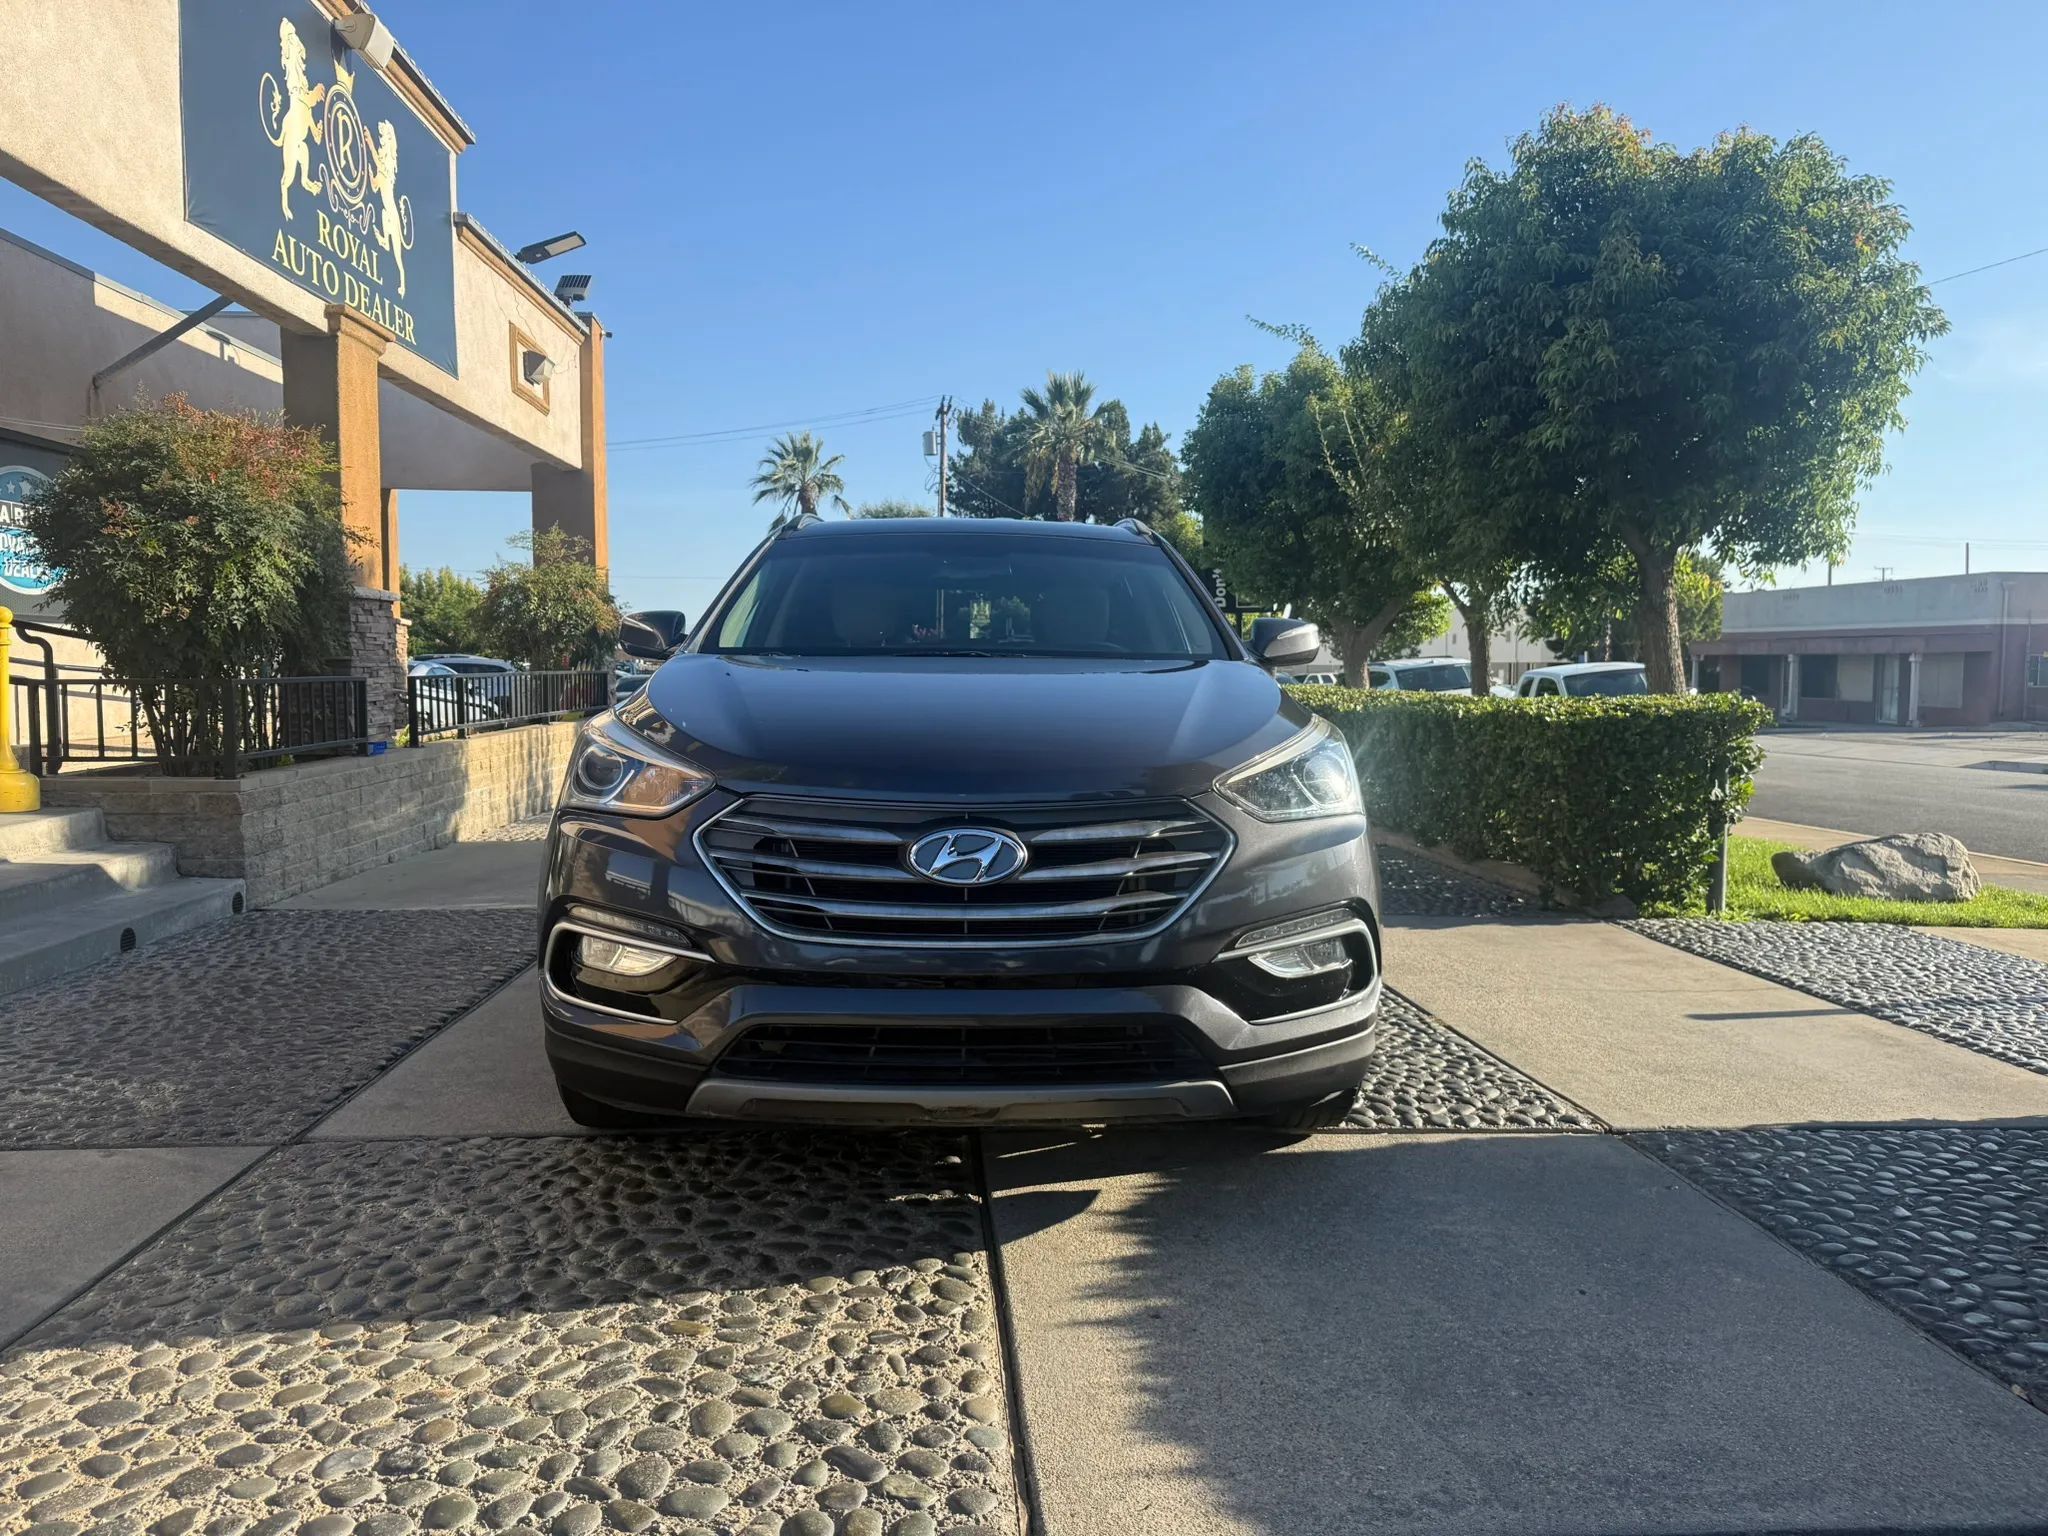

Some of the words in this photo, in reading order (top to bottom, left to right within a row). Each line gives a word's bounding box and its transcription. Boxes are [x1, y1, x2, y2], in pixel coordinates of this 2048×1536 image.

[271, 228, 339, 296] AUTO
[343, 271, 417, 346] DEALER
[316, 209, 383, 285] ROYAL
